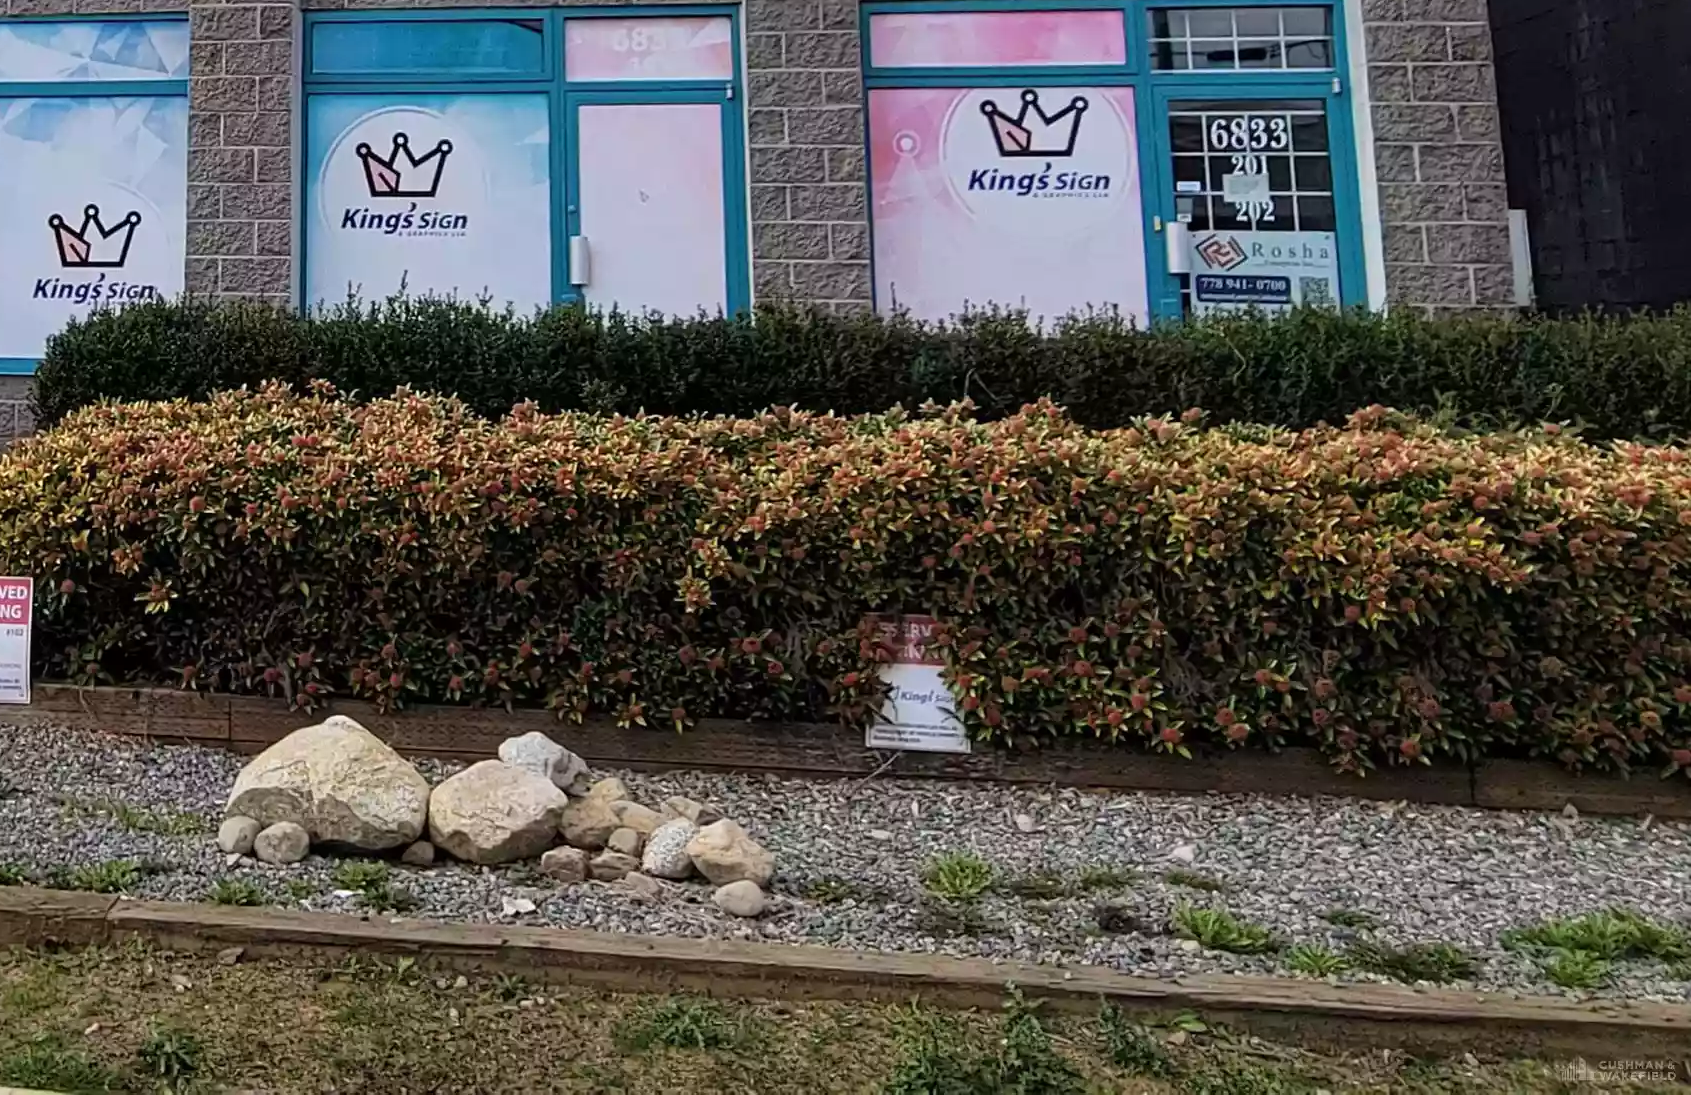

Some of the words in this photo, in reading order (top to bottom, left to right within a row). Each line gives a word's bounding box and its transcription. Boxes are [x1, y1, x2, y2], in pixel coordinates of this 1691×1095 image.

[1211, 118, 1288, 149] 6833
[1231, 155, 1268, 175] 201
[968, 162, 1052, 196] King's
[341, 202, 417, 234] King's
[1235, 200, 1276, 222] 202
[1252, 242, 1329, 259] Rosha
[33, 272, 106, 304] King's
[1200, 277, 1223, 289] 778
